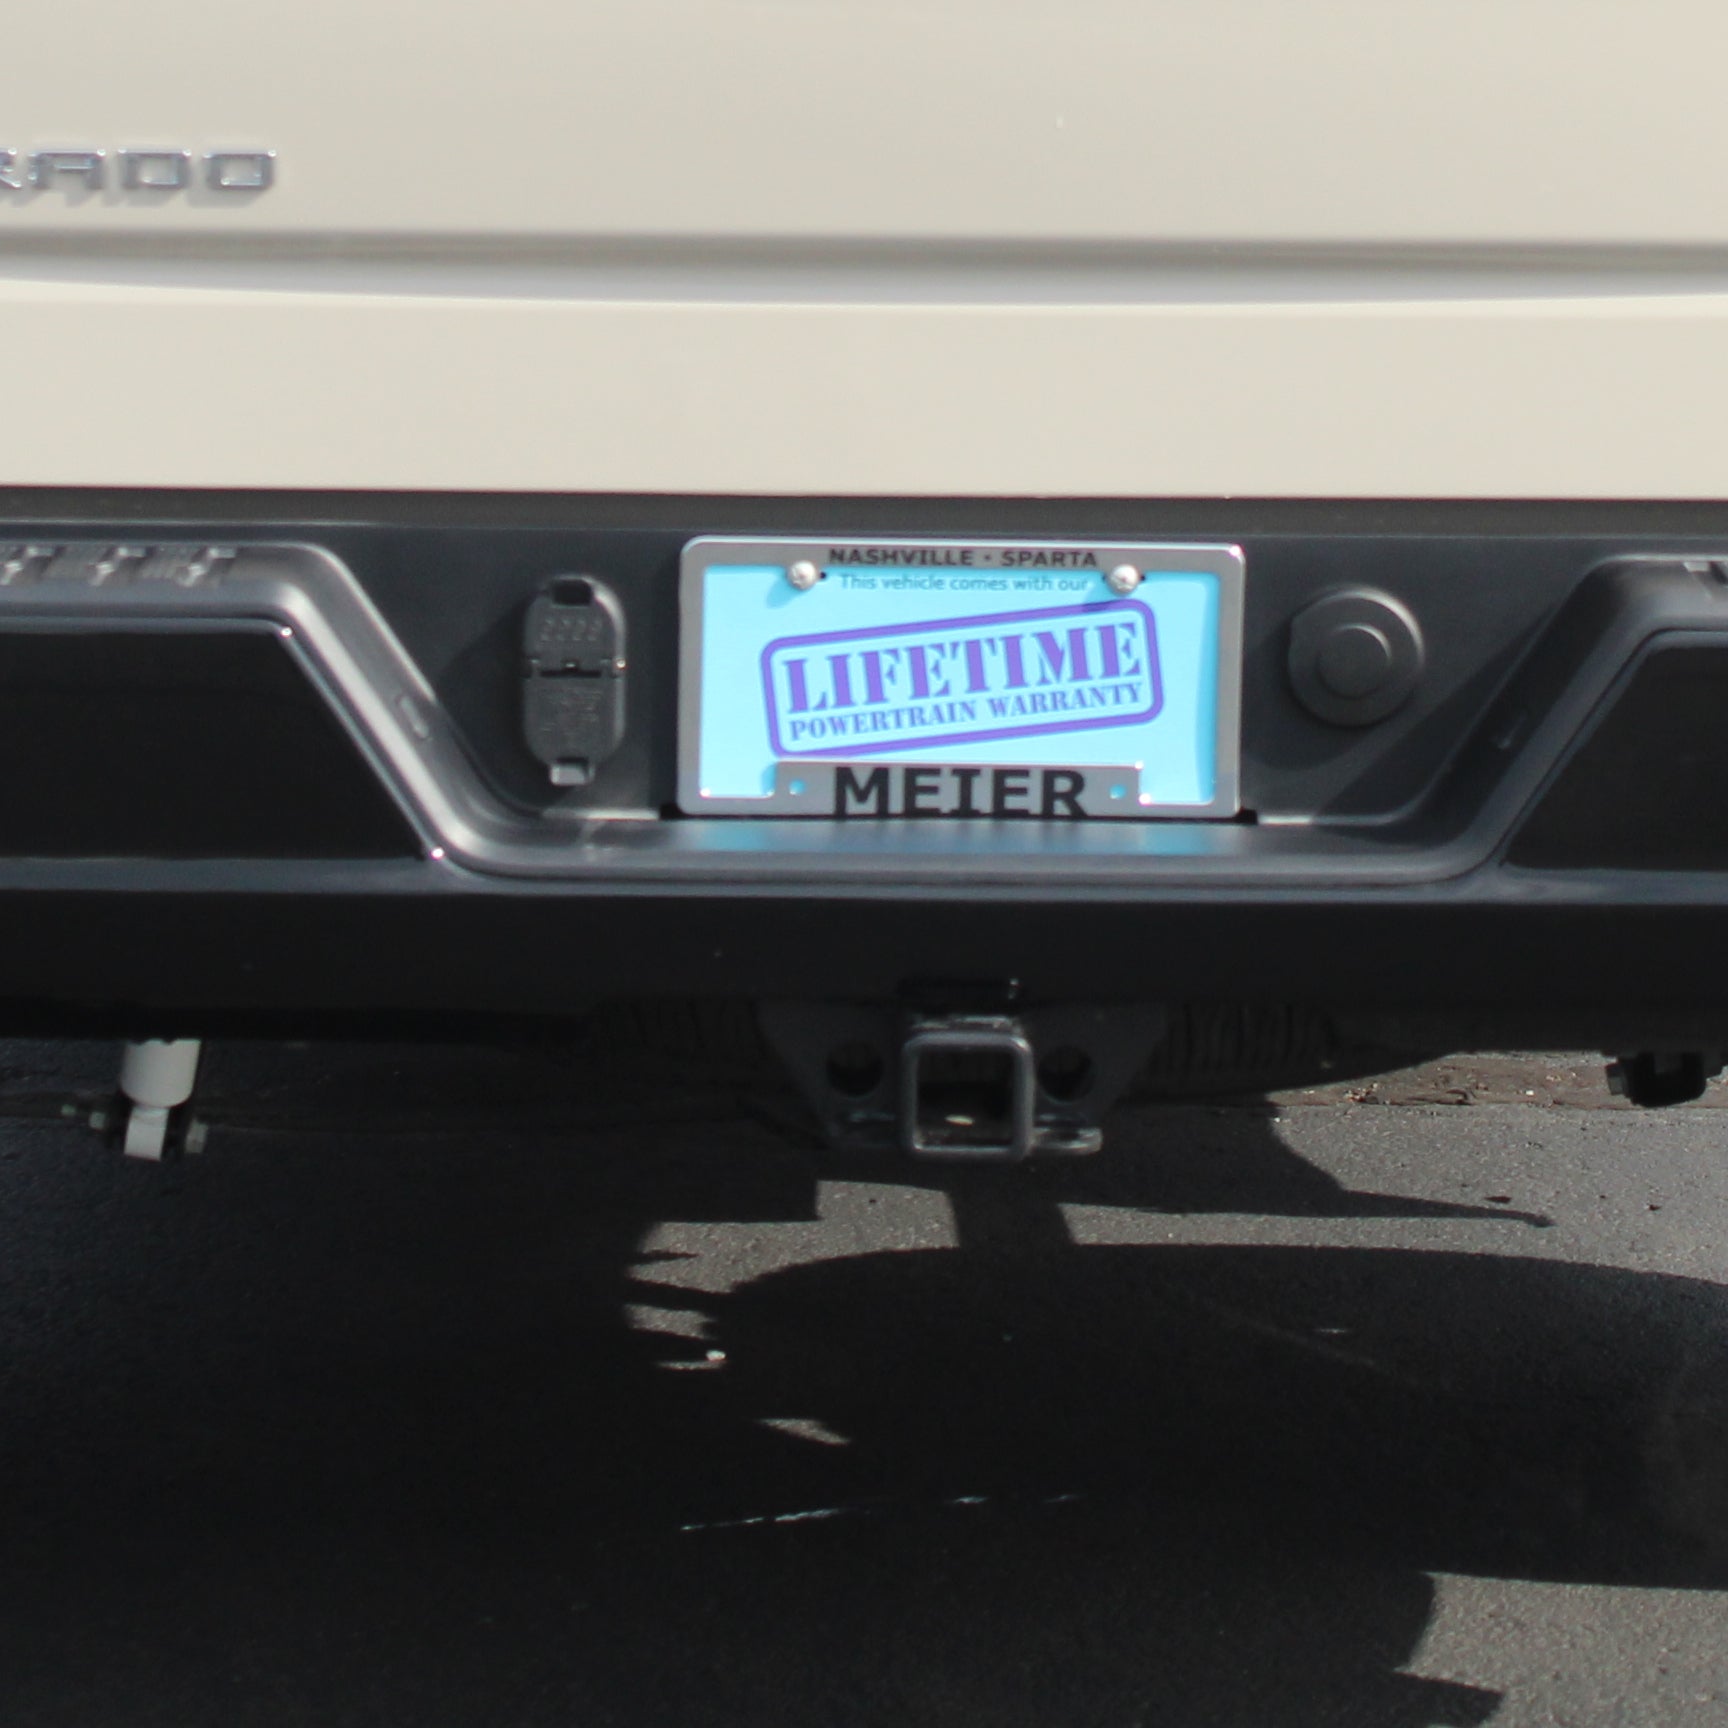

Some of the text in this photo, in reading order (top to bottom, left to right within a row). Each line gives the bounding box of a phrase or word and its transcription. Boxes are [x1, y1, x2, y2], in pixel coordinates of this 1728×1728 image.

[828, 548, 1098, 568] NASHVILLE SPARTA
[840, 574, 1089, 592] This vehicle comes with our
[782, 621, 1142, 715] LIFETIME
[789, 681, 1143, 742] POWERTRAIN WARRANTY
[834, 766, 1088, 819] MEIER
